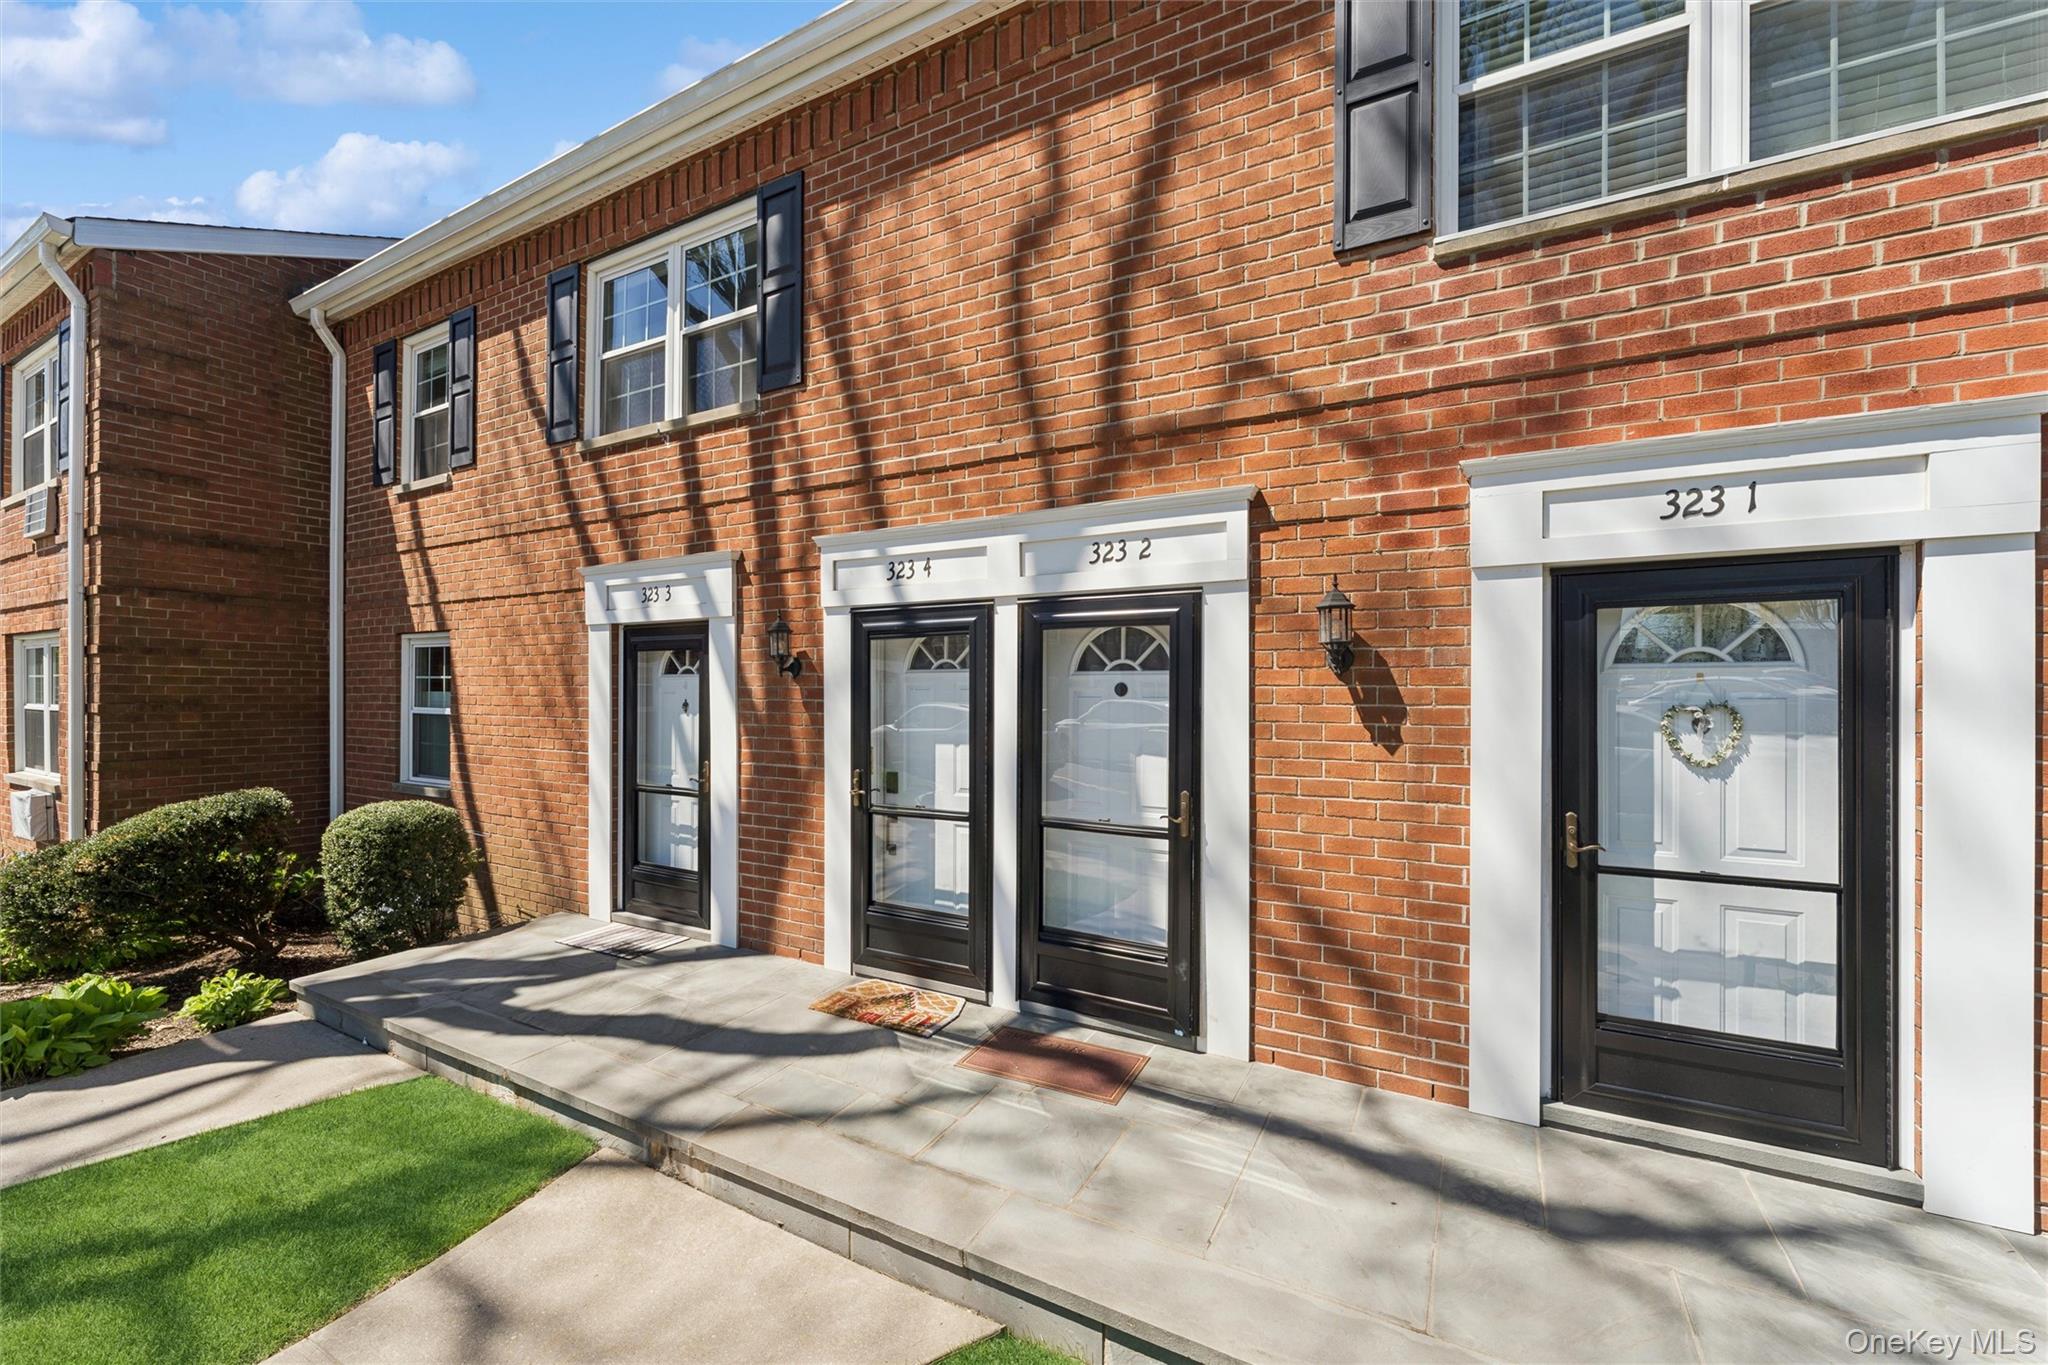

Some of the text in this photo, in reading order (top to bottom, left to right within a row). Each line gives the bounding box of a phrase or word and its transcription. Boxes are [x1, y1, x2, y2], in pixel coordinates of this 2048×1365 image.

[1660, 481, 1757, 520] 323 1
[1089, 537, 1151, 564] 323 2
[886, 557, 932, 581] 323 4
[641, 584, 672, 603] 323 3
